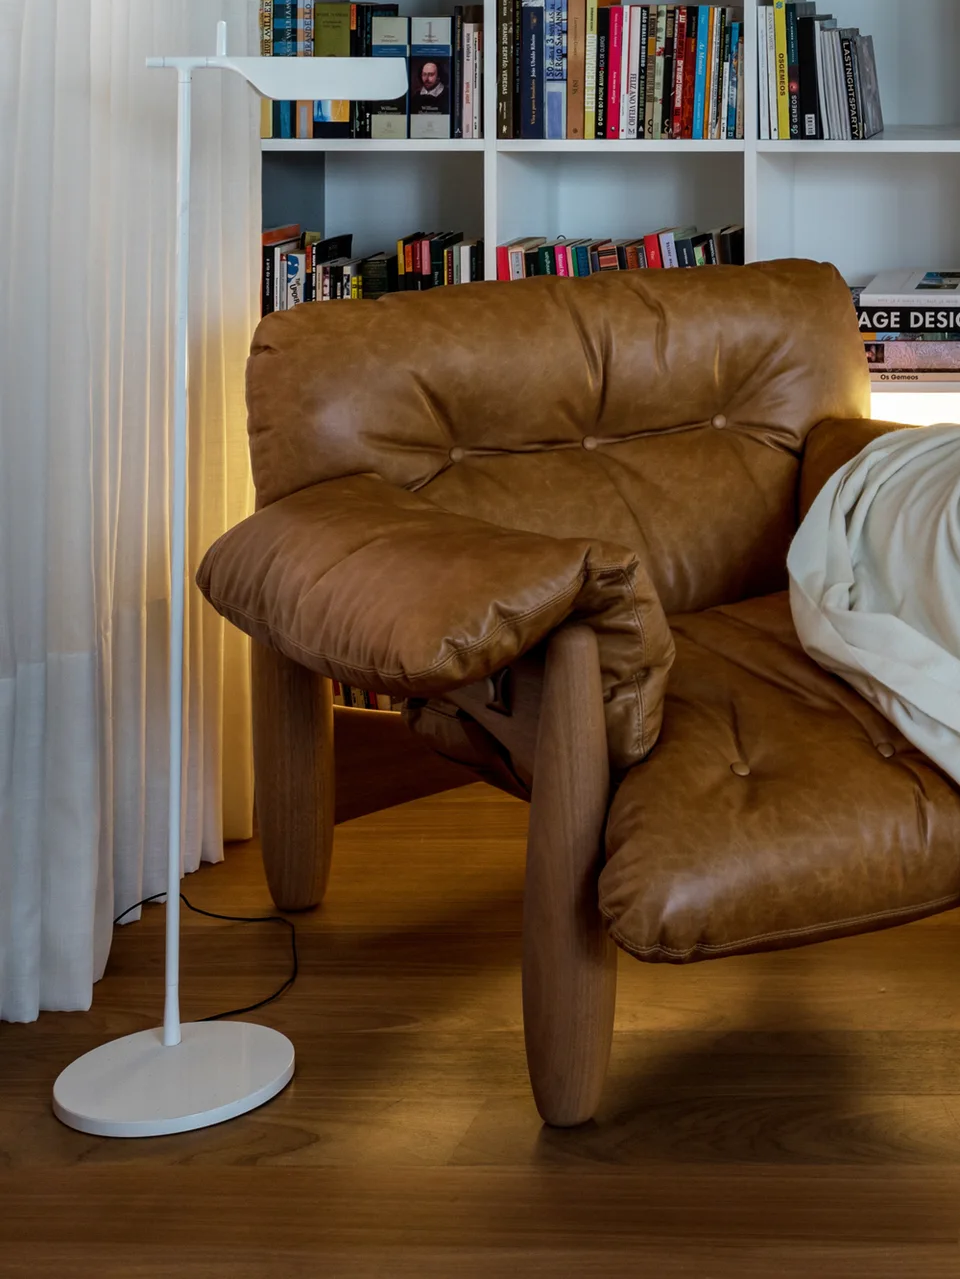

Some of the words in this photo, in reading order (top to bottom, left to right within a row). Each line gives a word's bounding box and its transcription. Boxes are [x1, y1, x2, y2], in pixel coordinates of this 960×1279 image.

[263, 0, 272, 38] MILLER
[304, 3, 312, 57] PIRANDELLO
[640, 24, 648, 45] UBALDO
[698, 41, 705, 50] As
[501, 45, 510, 69] SERTÃO:
[585, 33, 596, 88] DERRAMADO
[501, 69, 509, 95] VEREDAS
[629, 73, 638, 89] FELIZ
[778, 52, 786, 97] OSGEMEOS
[585, 88, 596, 113] LEITE
[628, 90, 637, 105] ANO
[842, 41, 859, 137] LASTNIGHTSPARTY
[627, 104, 636, 126] VELHO
[858, 311, 901, 328] AGE
